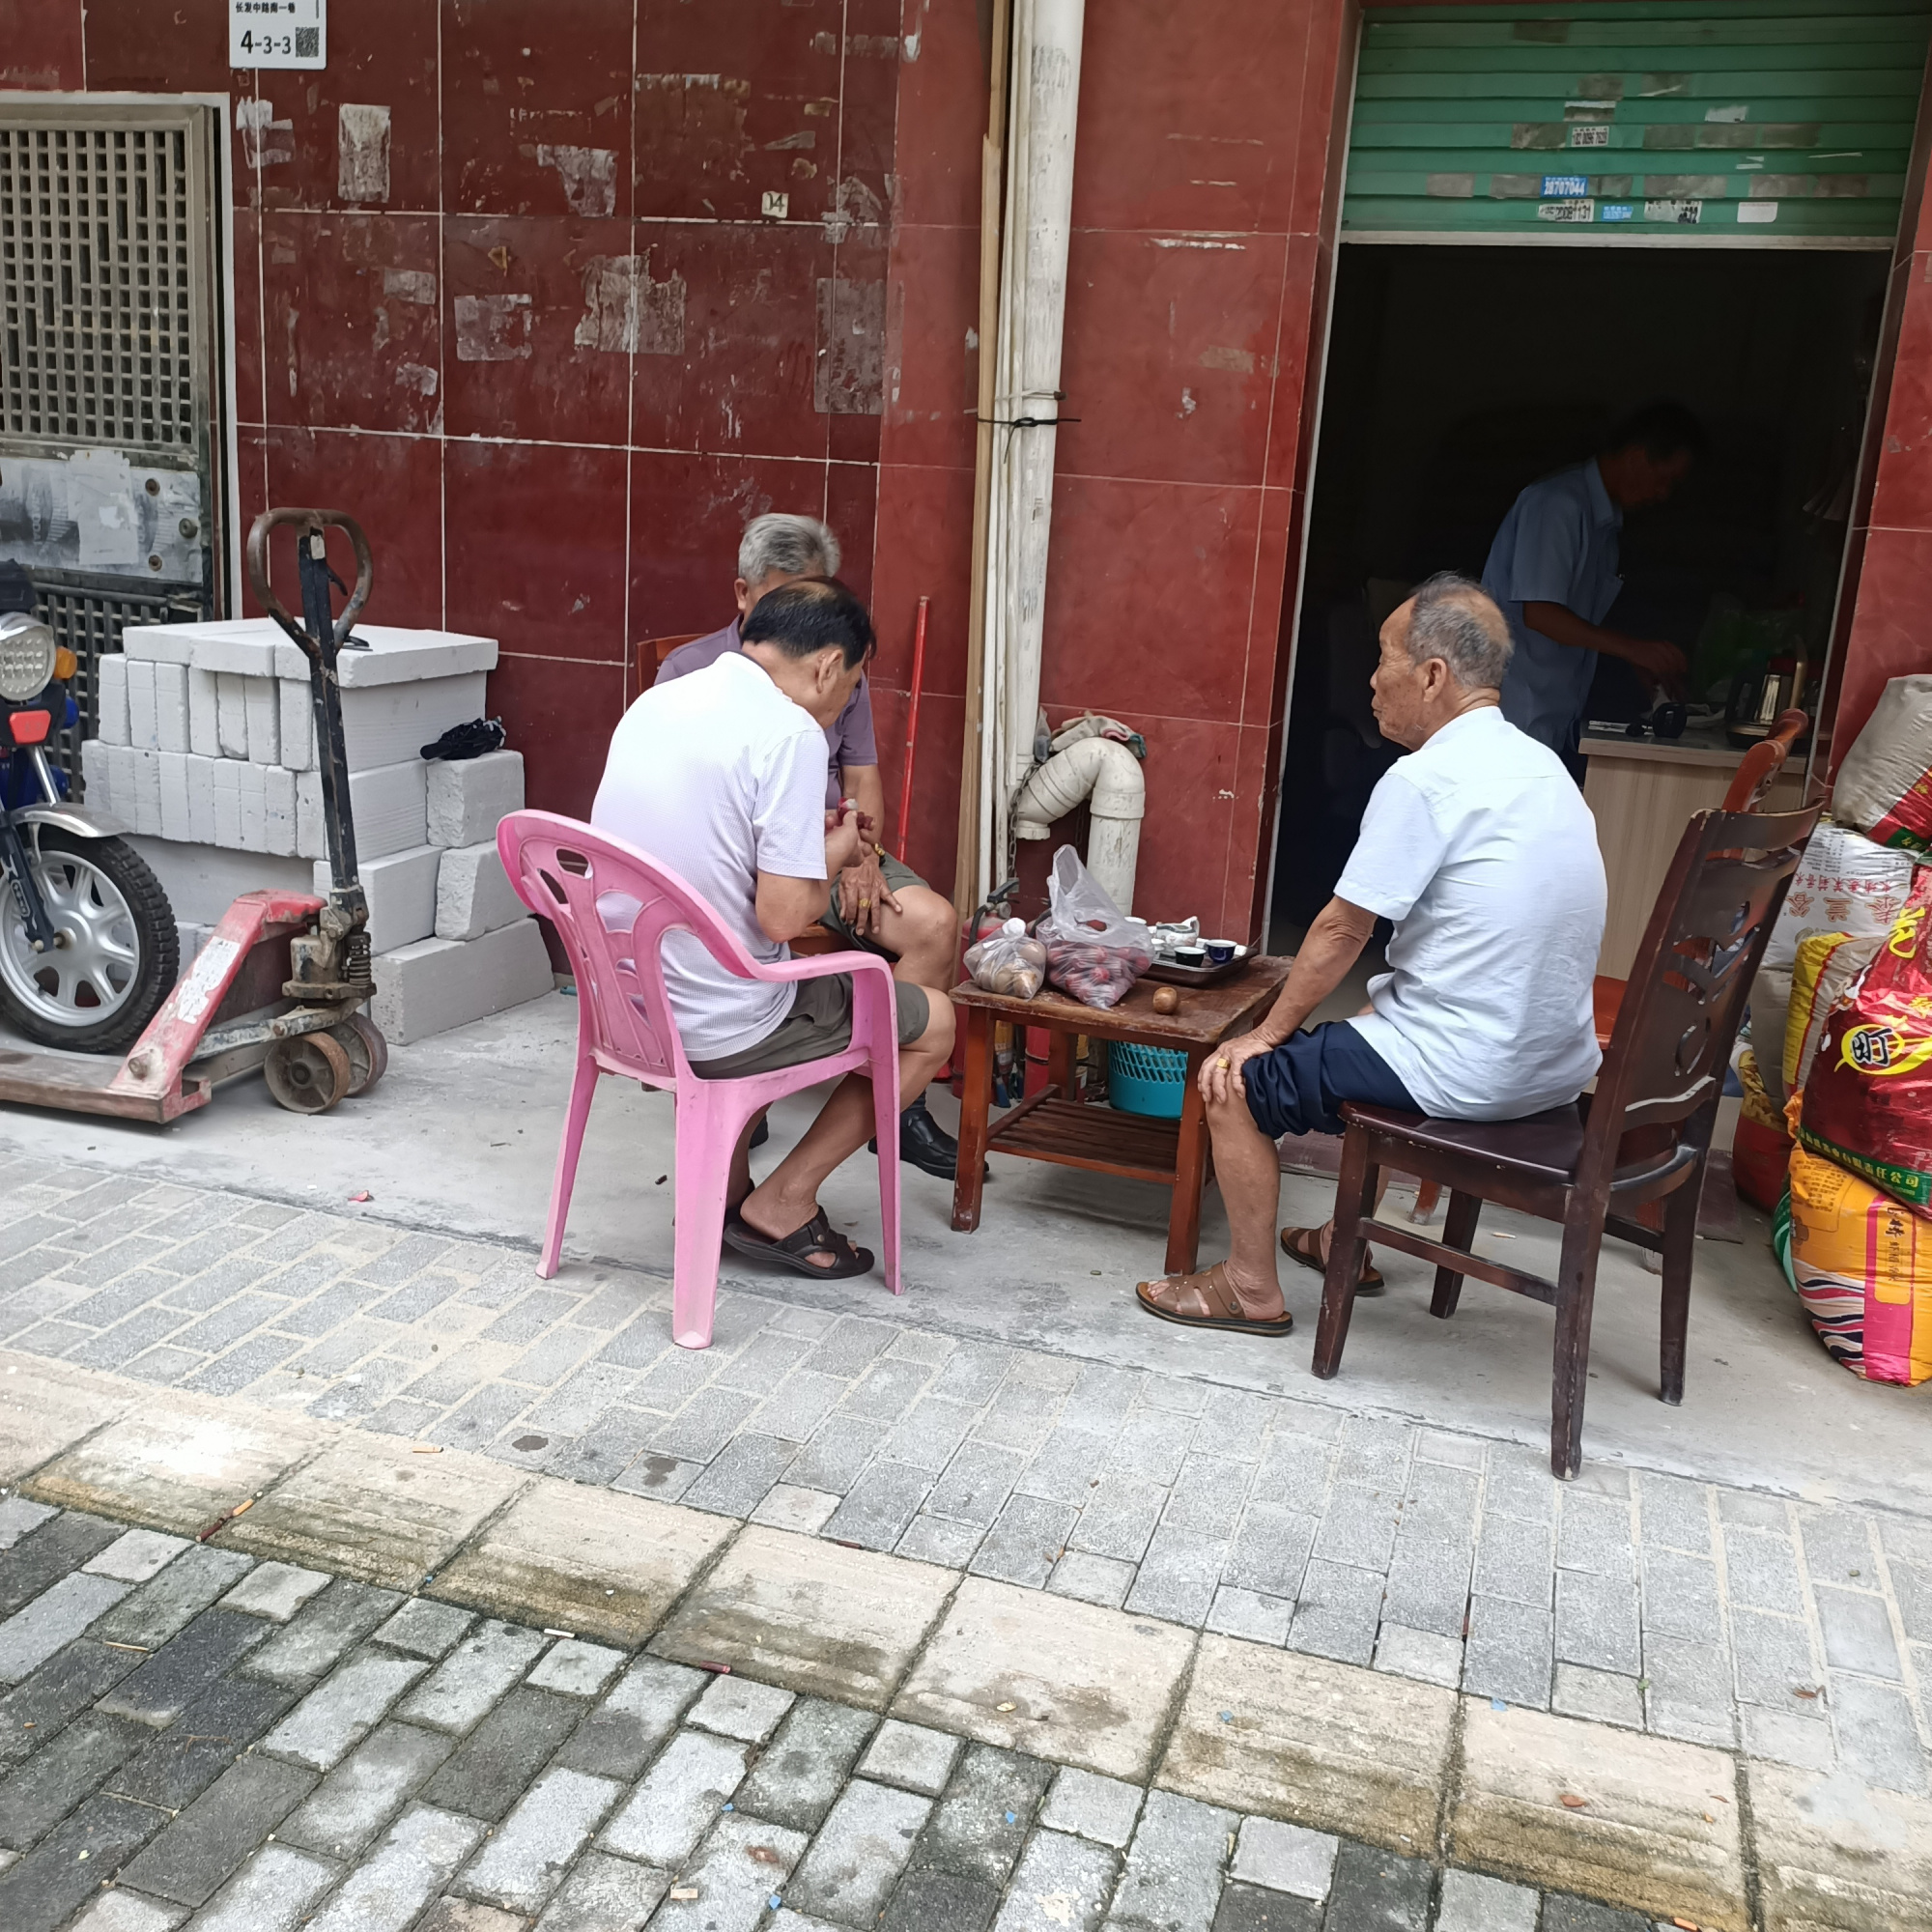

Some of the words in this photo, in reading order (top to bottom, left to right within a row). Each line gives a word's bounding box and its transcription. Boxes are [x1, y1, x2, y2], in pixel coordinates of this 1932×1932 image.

[241, 30, 291, 54] 4-3-3
[1786, 892, 1901, 925] 泰兰谷
